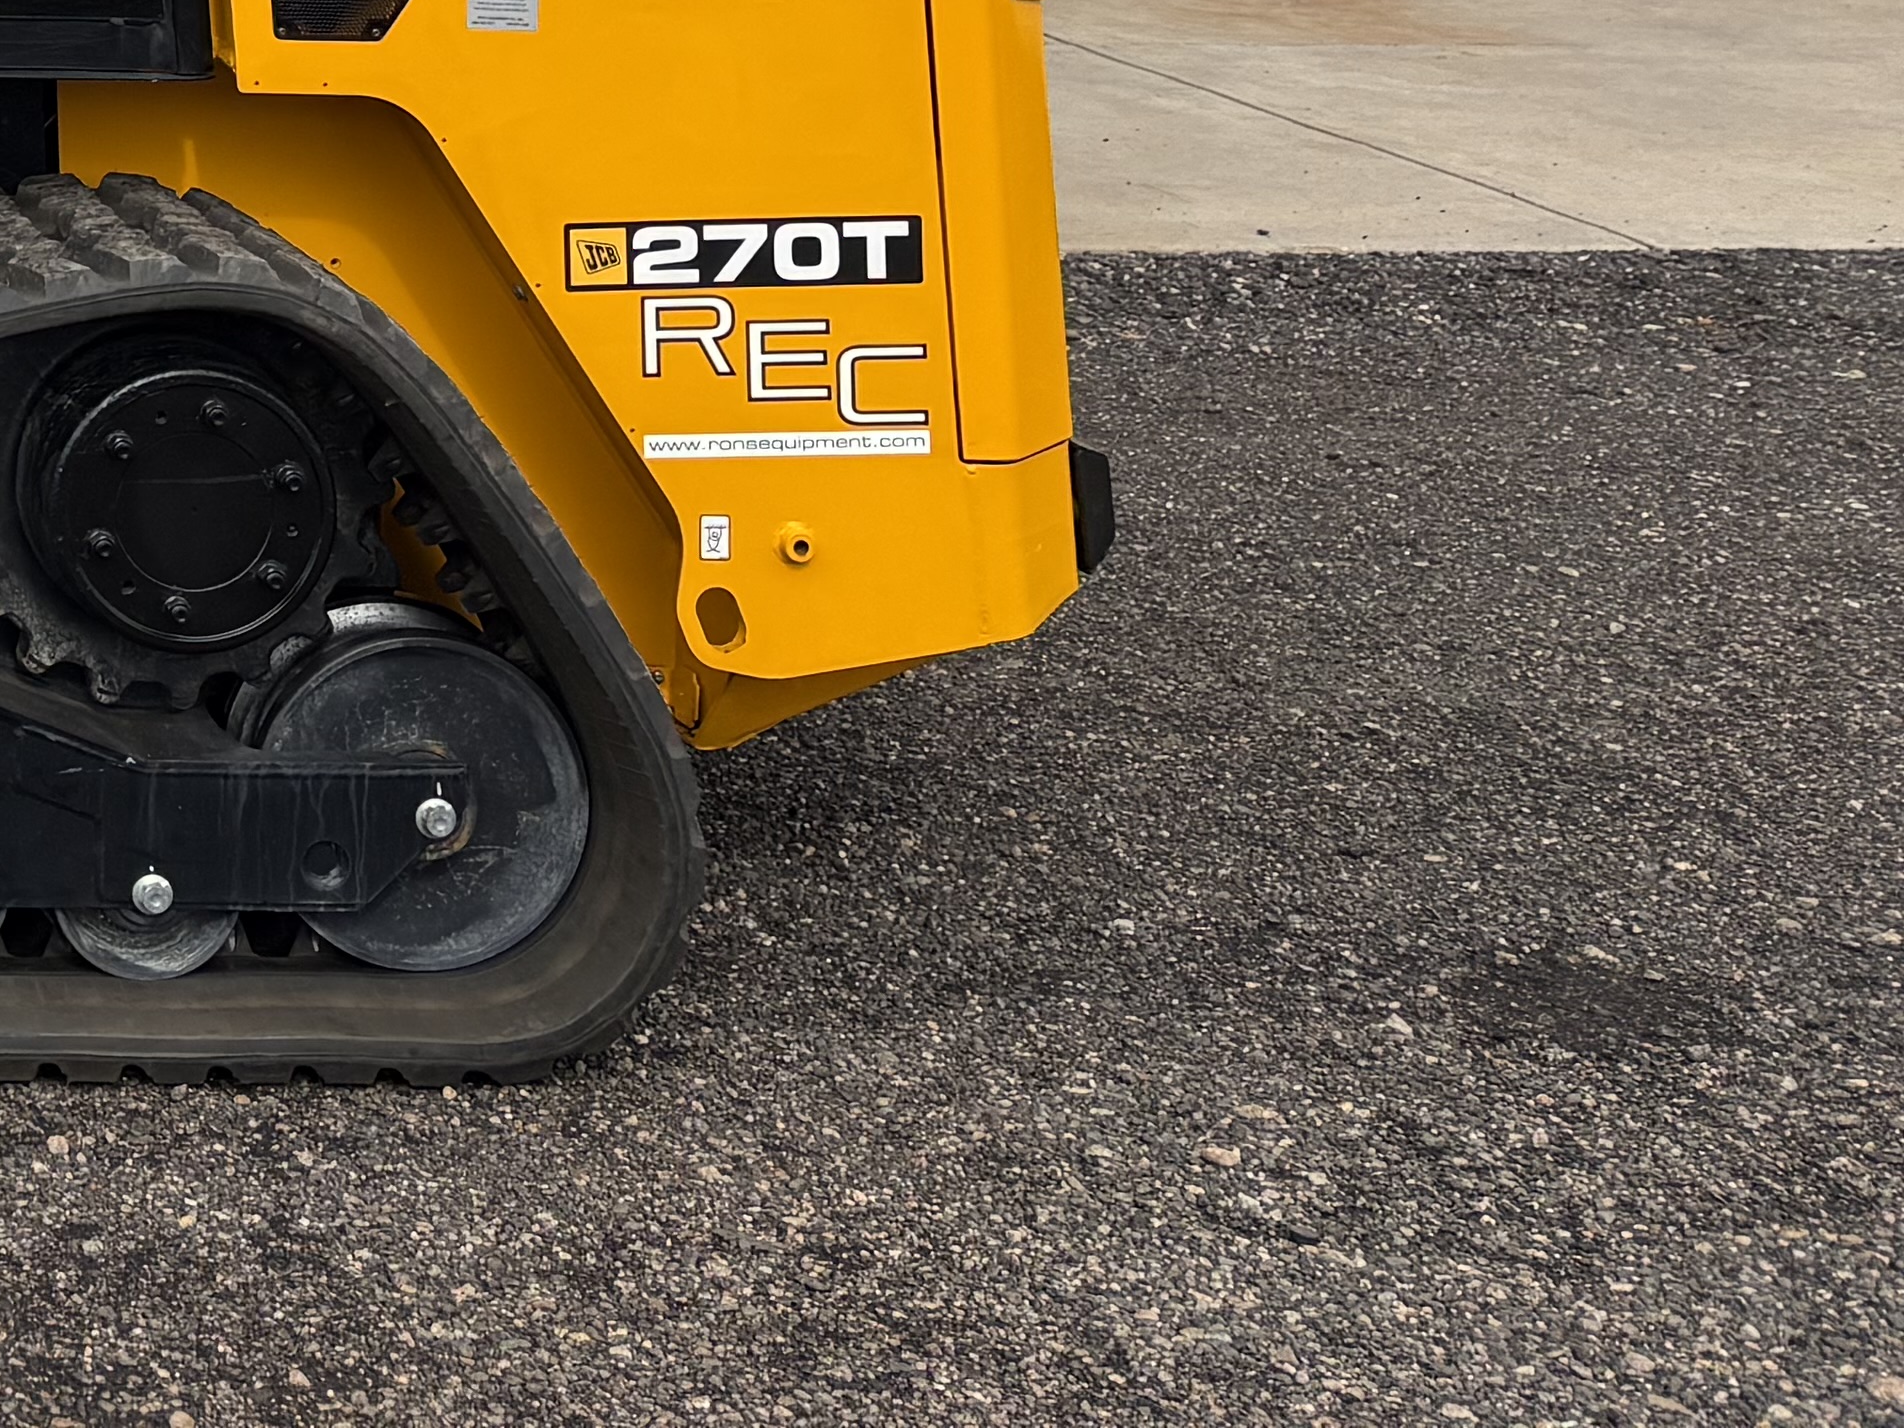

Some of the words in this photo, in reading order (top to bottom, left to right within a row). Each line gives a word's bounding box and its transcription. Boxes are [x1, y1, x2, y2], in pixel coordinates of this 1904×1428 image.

[585, 243, 620, 270] JCB
[632, 221, 910, 285] 270T
[640, 294, 930, 426] REC
[648, 434, 926, 453] www.ronsequipment.com
